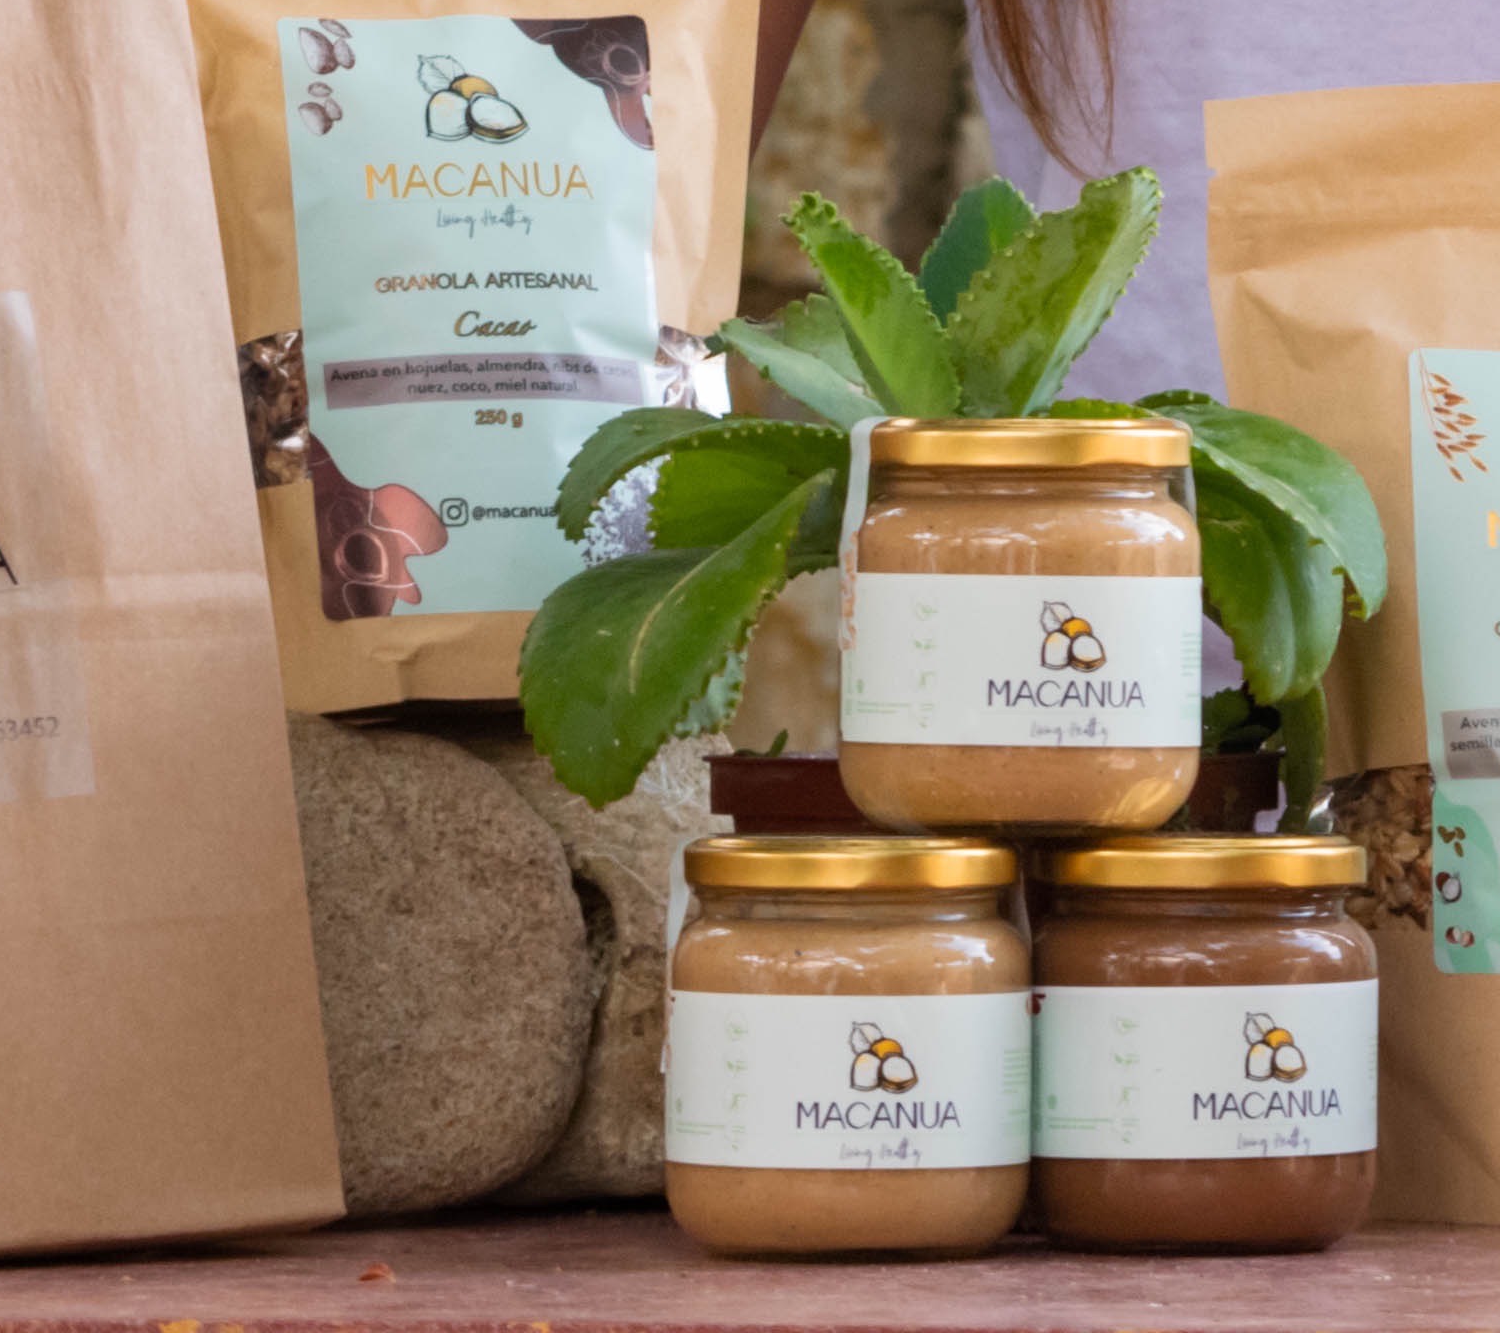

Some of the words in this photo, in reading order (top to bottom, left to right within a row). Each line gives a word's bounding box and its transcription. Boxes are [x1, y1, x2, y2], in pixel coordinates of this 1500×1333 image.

[365, 161, 594, 199] MACANUA
[374, 272, 479, 293] GRANOLA
[484, 271, 598, 291] ARTESANAL
[453, 310, 538, 338] Cacao
[330, 366, 378, 381] Avena
[382, 367, 400, 379] en
[494, 378, 527, 392] miel
[475, 409, 507, 425] 250
[511, 410, 524, 428] g
[472, 504, 557, 521] @macanua
[987, 679, 1145, 709] MACANUA
[795, 1100, 961, 1130] MACANUA
[1192, 1087, 1343, 1122] MACANUA
